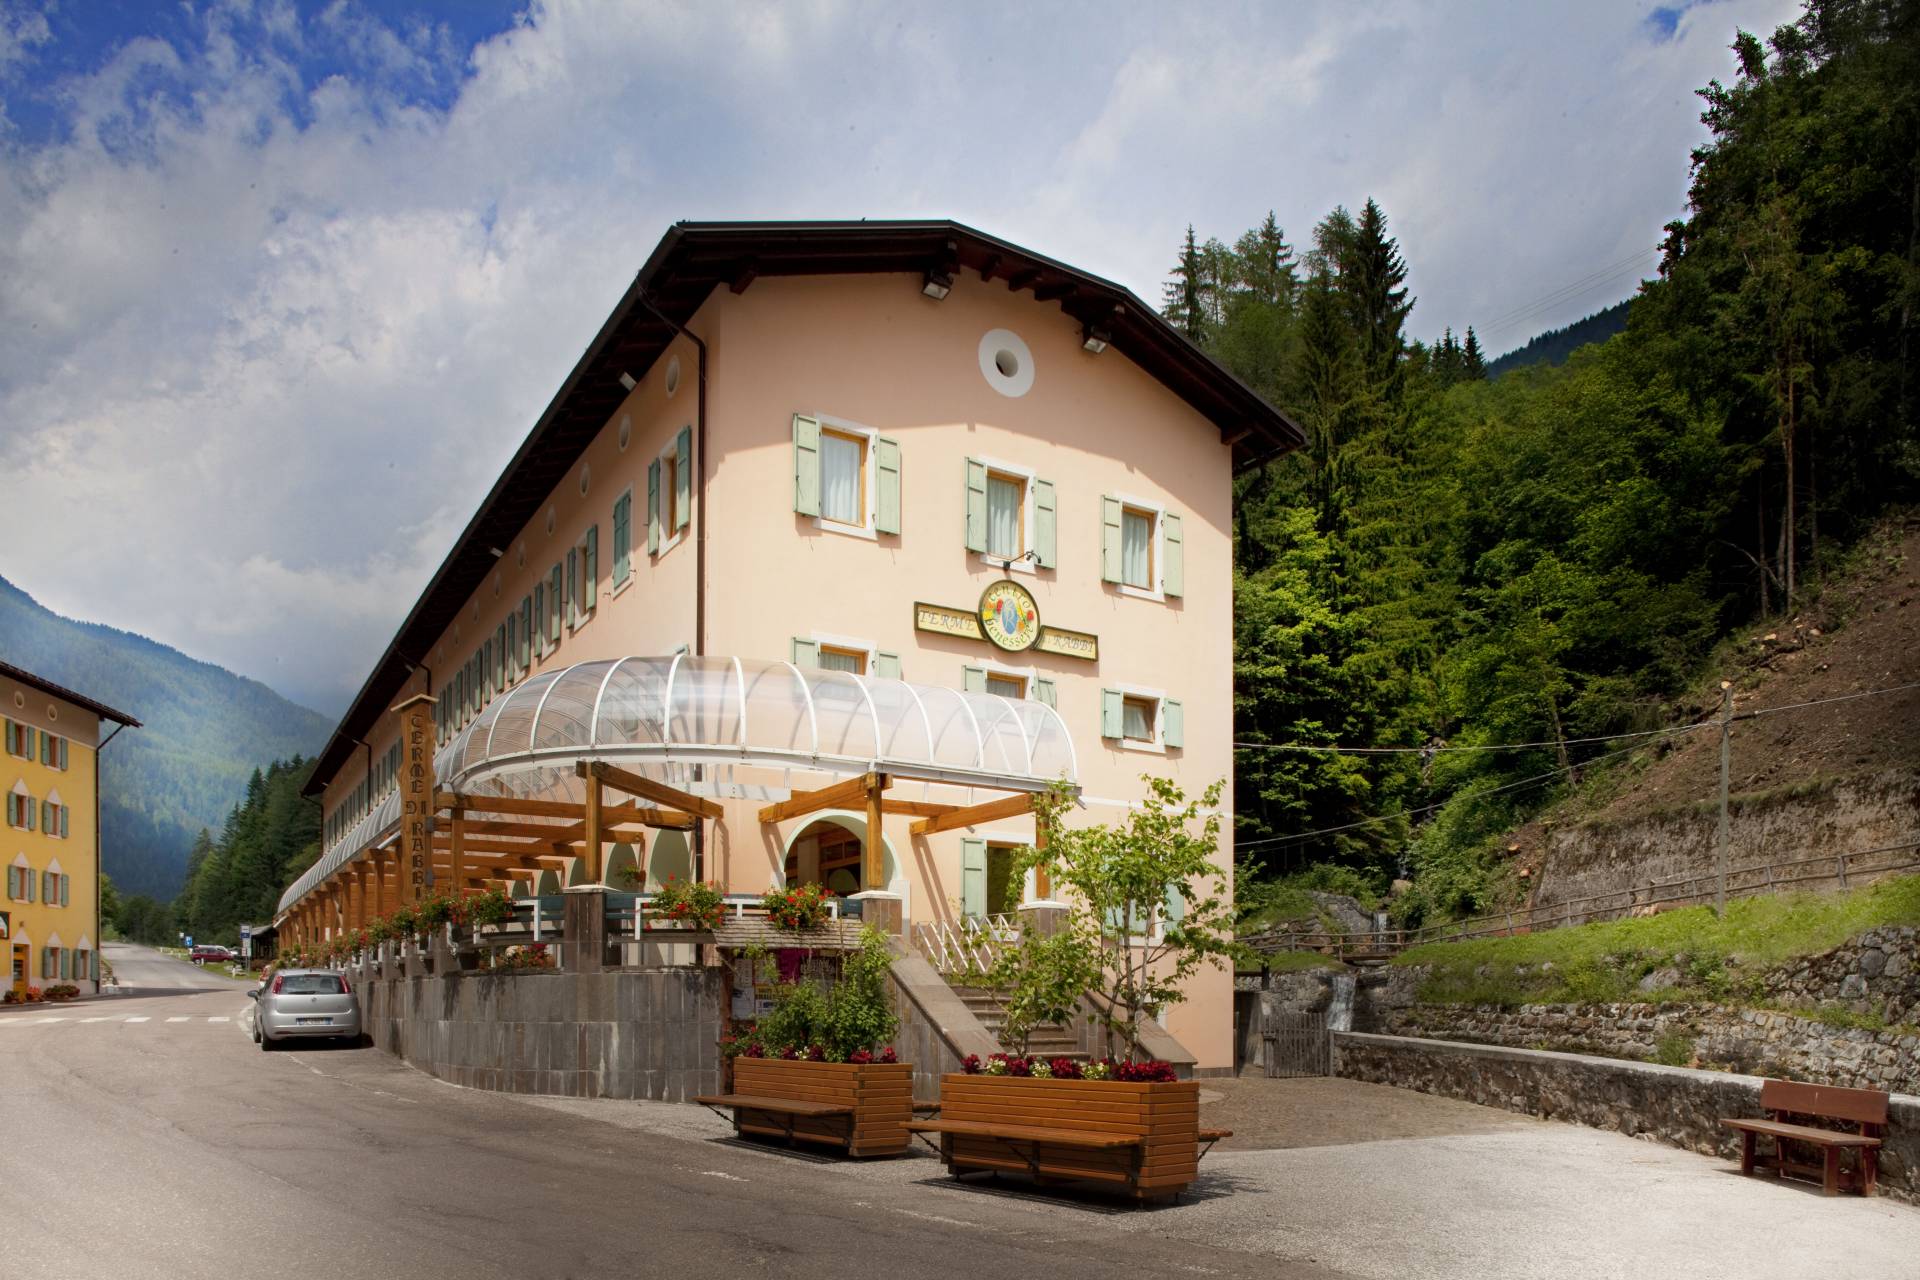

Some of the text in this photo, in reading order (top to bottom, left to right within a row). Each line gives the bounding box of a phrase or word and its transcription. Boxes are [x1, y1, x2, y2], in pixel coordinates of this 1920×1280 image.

[919, 609, 976, 631] TERME
[984, 618, 1034, 647] benessere
[1053, 634, 1095, 653] RABBI
[405, 800, 427, 815] DI
[411, 822, 424, 901] RABBI
